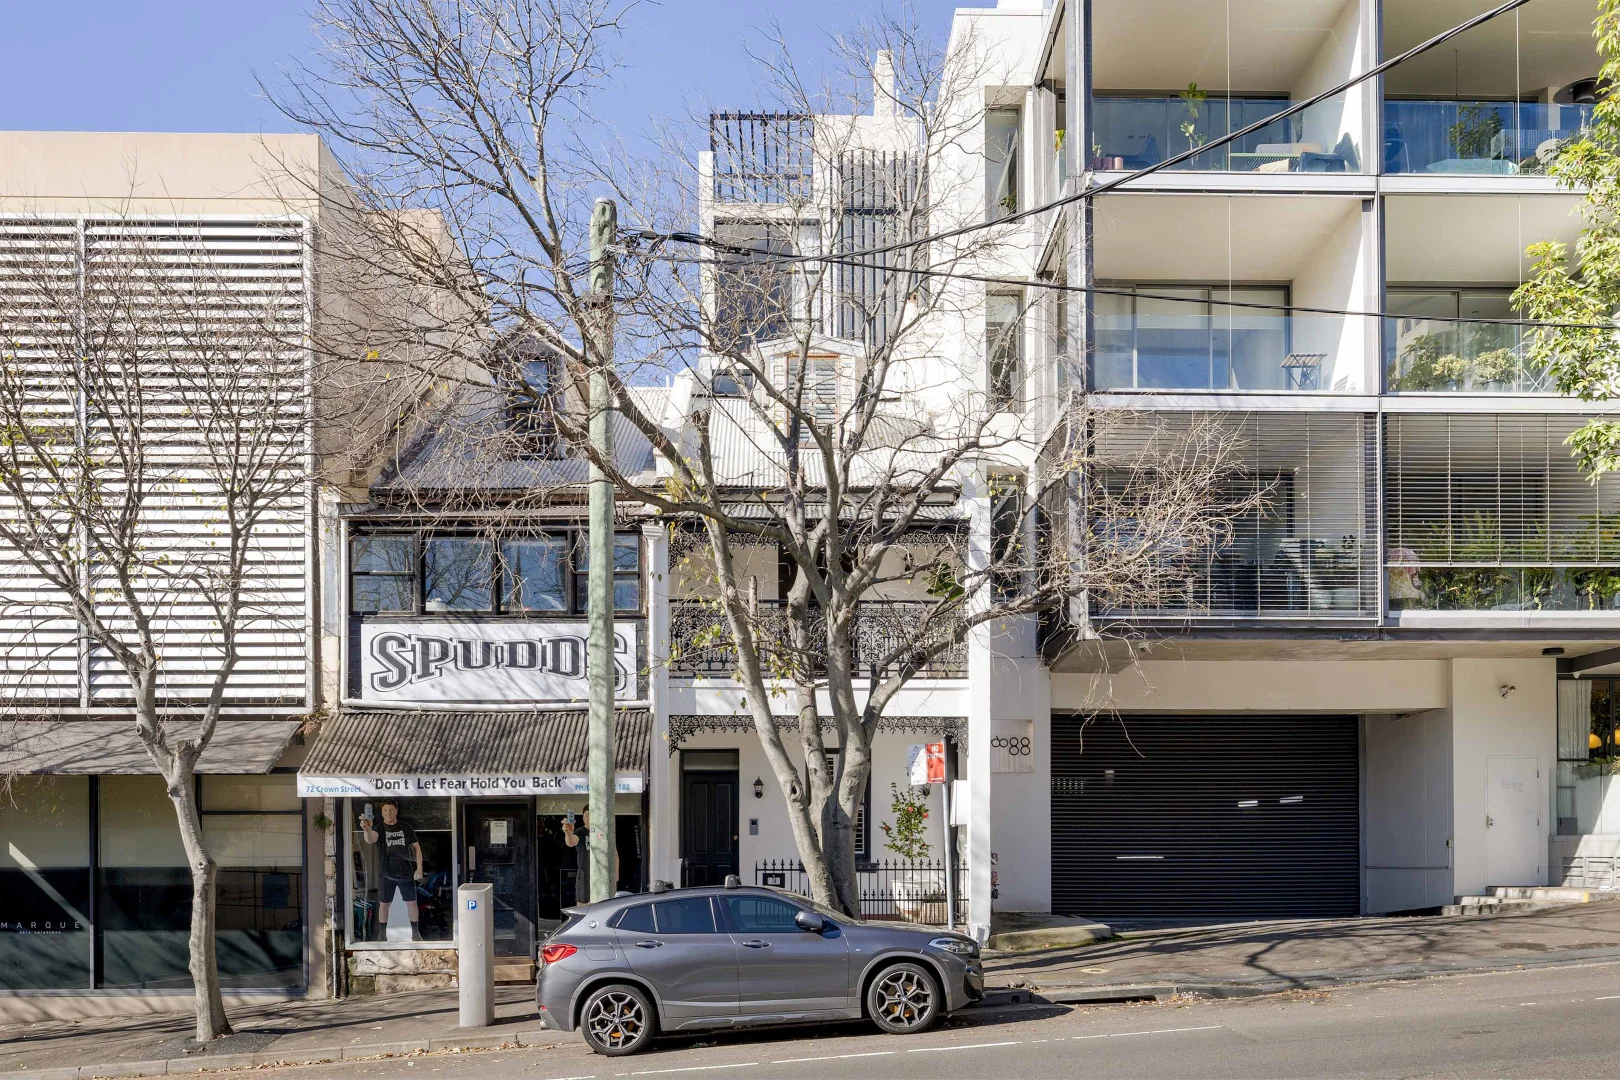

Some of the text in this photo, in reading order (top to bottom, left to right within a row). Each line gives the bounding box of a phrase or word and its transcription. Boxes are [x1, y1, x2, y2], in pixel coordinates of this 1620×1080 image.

[417, 778, 438, 790] Let
[440, 778, 467, 790] Fear
[470, 777, 499, 789] Hold
[503, 777, 526, 788] You
[0, 921, 80, 929] MARQUE
